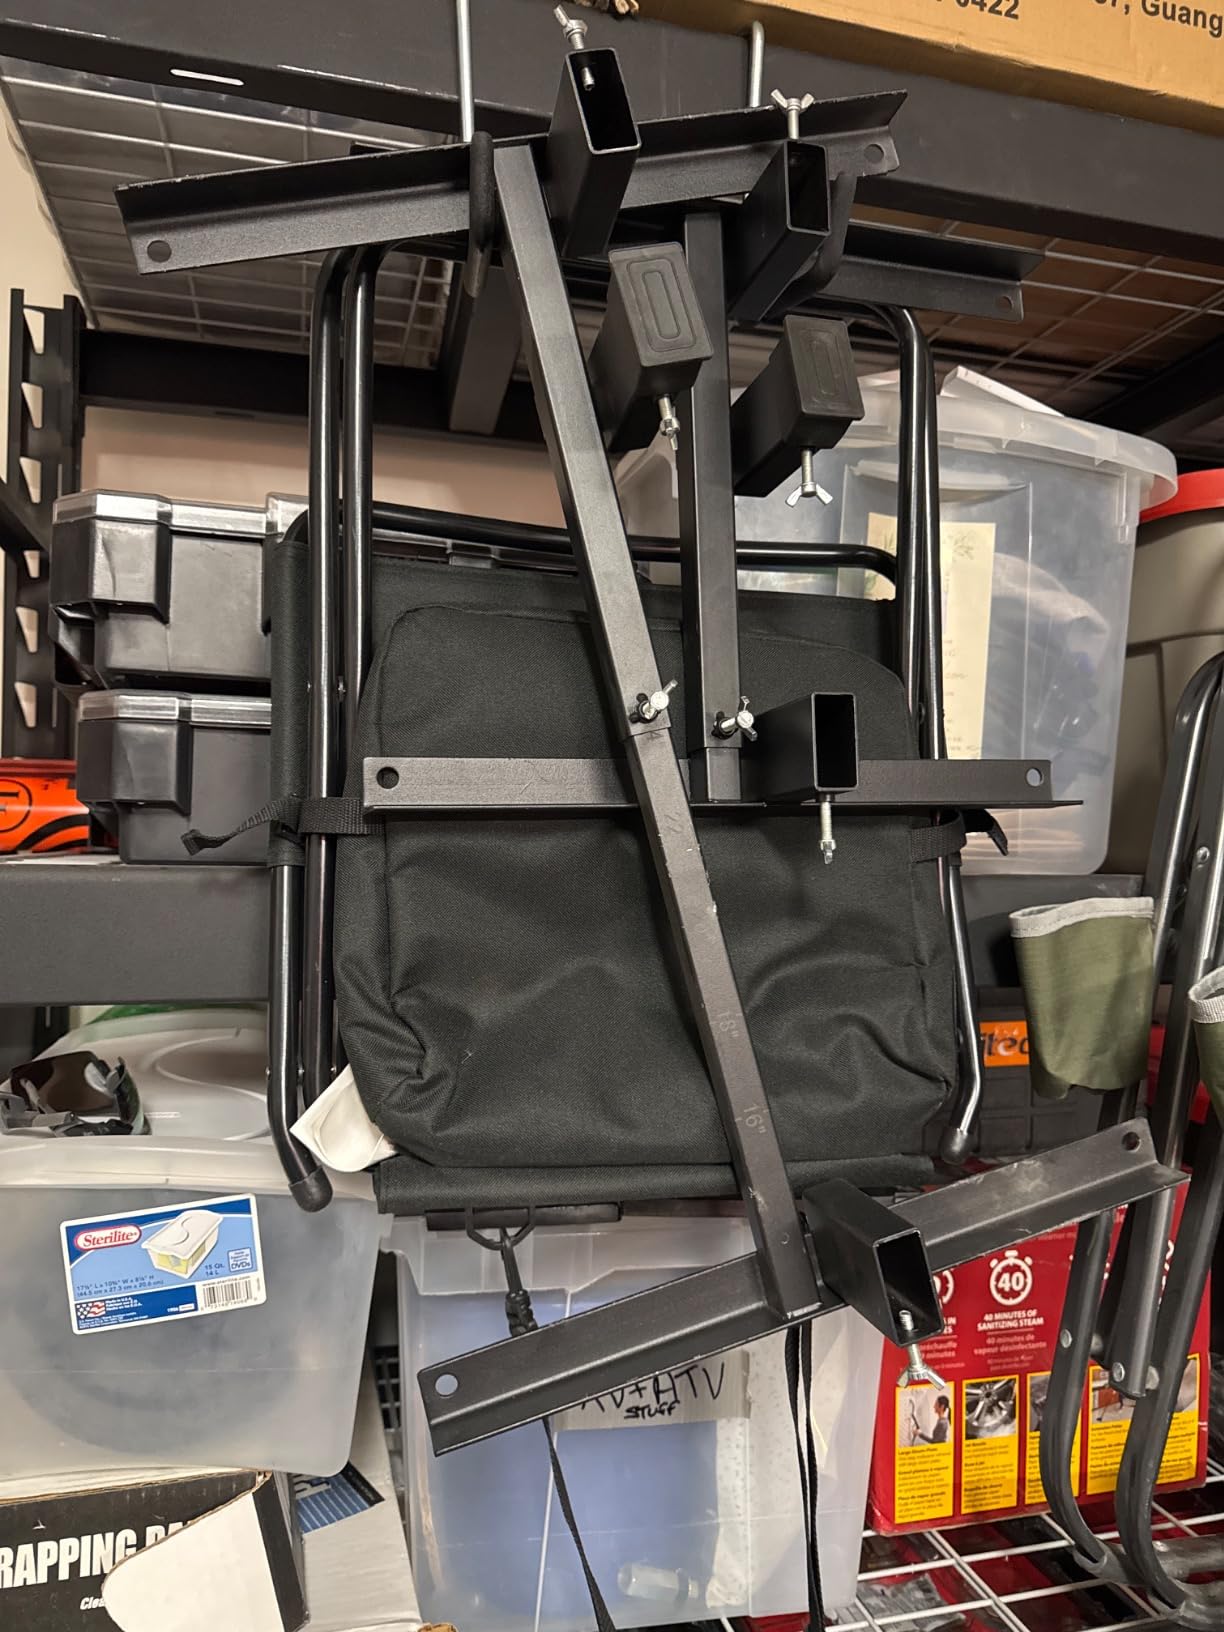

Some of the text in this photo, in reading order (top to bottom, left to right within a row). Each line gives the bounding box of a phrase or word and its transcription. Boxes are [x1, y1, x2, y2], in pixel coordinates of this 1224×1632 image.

[83, 1230, 133, 1247] Sterilite
[231, 1261, 251, 1270] DVDs
[997, 1271, 1025, 1292] 40
[983, 1309, 1038, 1321] 40 MINUTES OF
[977, 1317, 1044, 1331] SANITIZING STEAM
